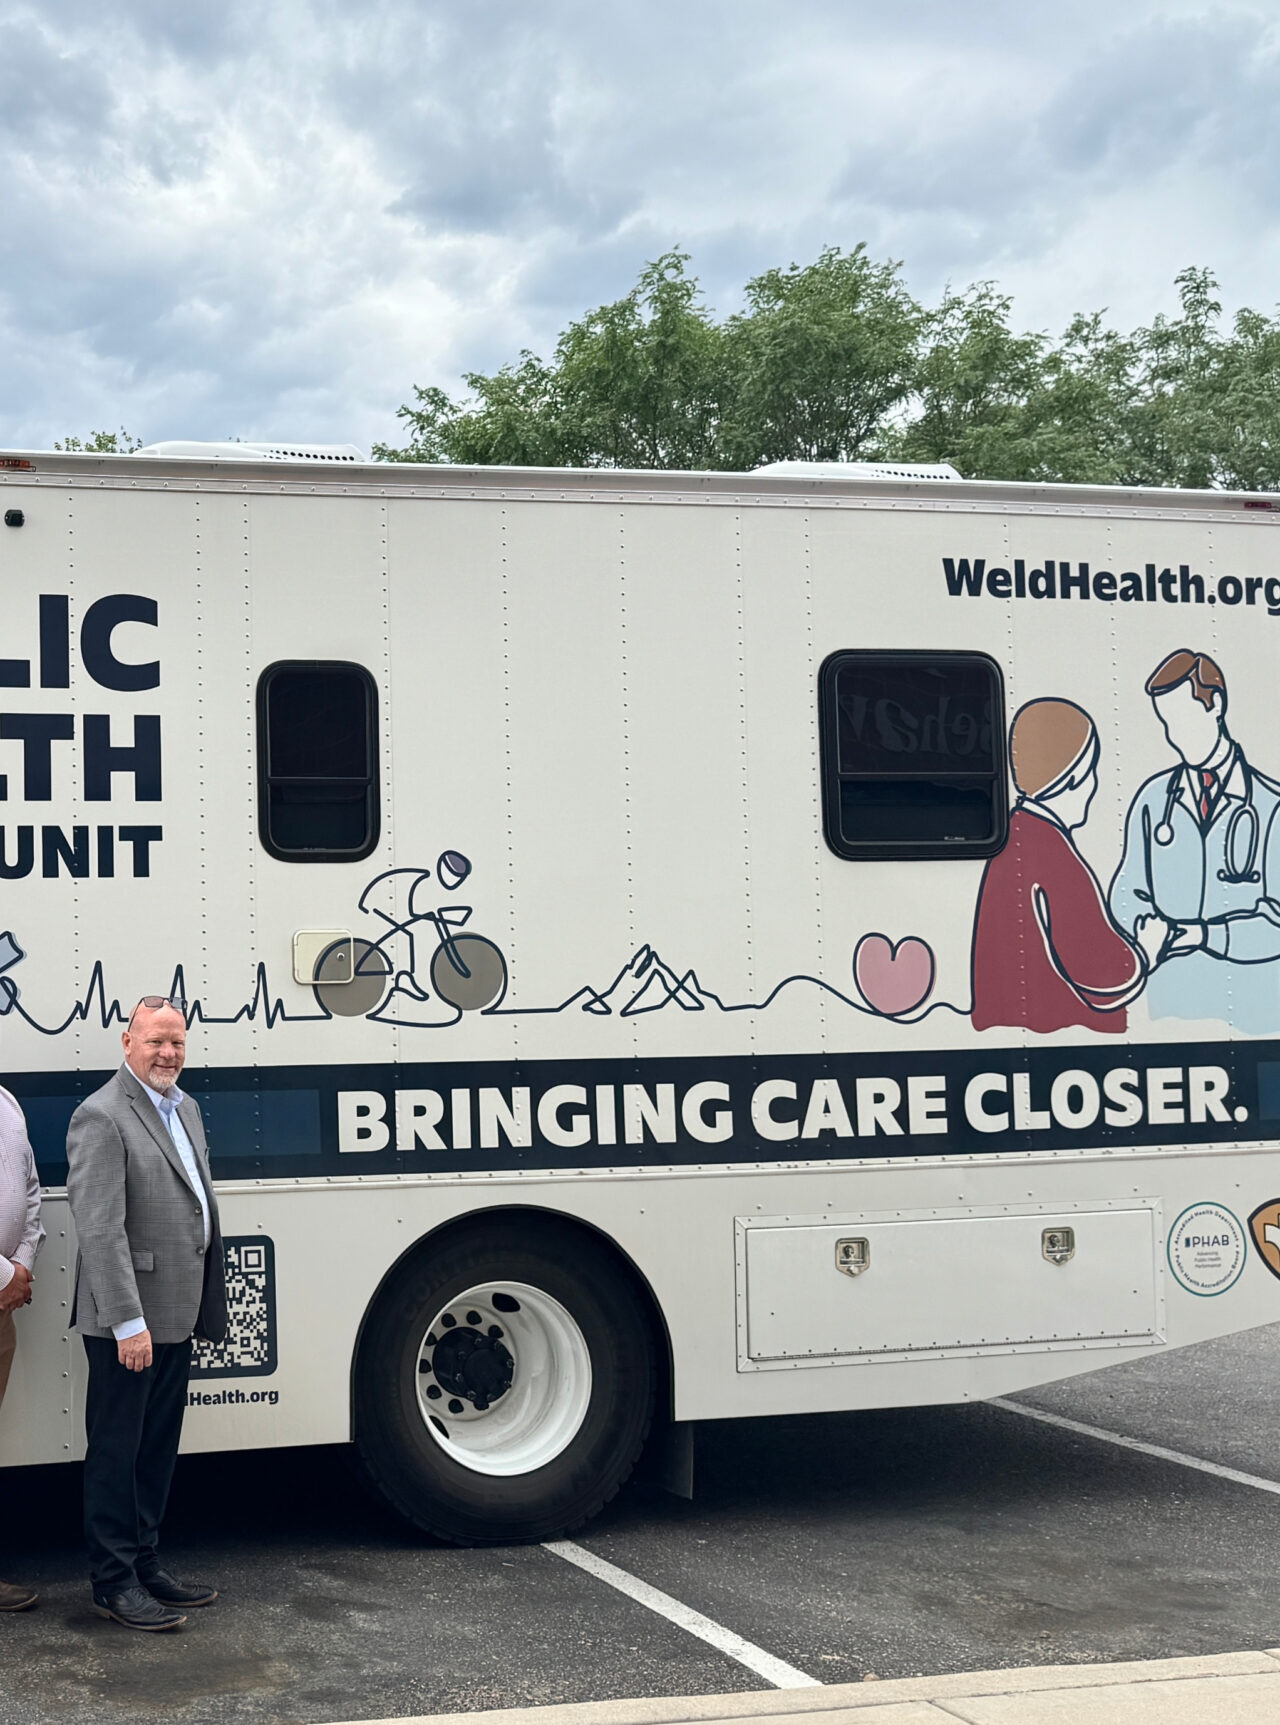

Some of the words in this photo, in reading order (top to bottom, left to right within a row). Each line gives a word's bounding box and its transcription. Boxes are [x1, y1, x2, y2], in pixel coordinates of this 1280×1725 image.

[337, 1080, 734, 1153] BRINGING
[751, 1075, 949, 1141] CARE
[964, 1065, 1249, 1134] CLOSER.
[1192, 1234, 1230, 1248] PHAB
[184, 1389, 280, 1407] Health.org
